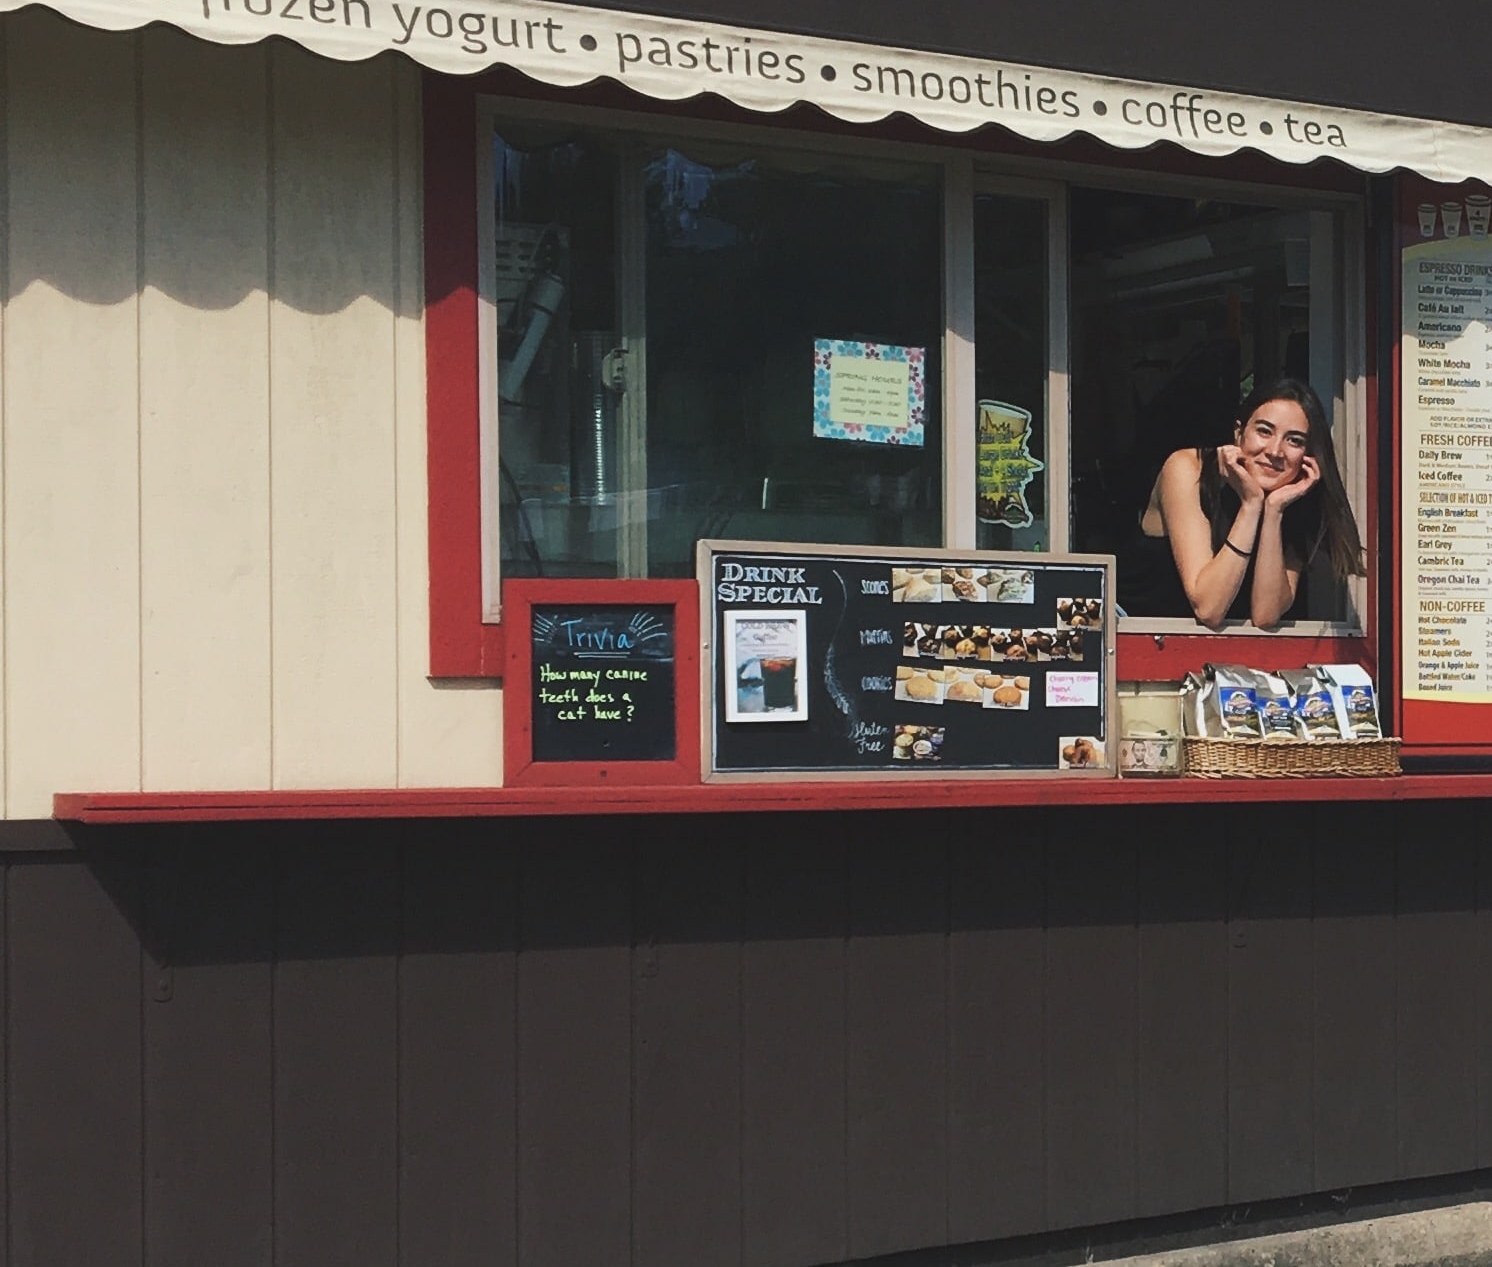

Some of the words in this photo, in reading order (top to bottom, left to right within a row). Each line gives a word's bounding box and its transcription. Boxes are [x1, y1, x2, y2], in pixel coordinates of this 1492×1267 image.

[390, 0, 568, 55] yogurt
[614, 31, 806, 86] pastries
[852, 59, 1082, 120] smoothies
[1120, 91, 1249, 139] coffee
[1283, 110, 1348, 150] tea
[1419, 262, 1463, 274] ESPRESSO
[1438, 304, 1450, 313] Au
[1418, 321, 1462, 332] Americano
[1418, 339, 1446, 350] Mocha
[1418, 358, 1442, 368] White
[1444, 360, 1471, 369] Mocha
[1418, 376, 1446, 386] Caramel
[1446, 378, 1481, 388] Macchiato
[1418, 395, 1456, 406] Espresso
[1420, 434, 1454, 446] FRESH
[1418, 450, 1439, 462] Daily
[1441, 450, 1463, 460] Brew
[1418, 471, 1436, 481] Iced
[1437, 471, 1463, 481] Coffee
[1419, 492, 1448, 503] SELECTION
[1449, 493, 1456, 503] OF
[1457, 493, 1469, 504] HOT
[1475, 494, 1487, 504] ICED
[1418, 507, 1443, 518] English
[1444, 508, 1478, 518] Breakfast
[1418, 523, 1440, 533] Green
[1442, 524, 1457, 533] Zen
[1418, 539, 1433, 549] Earl
[1434, 540, 1452, 551] Grey
[1418, 556, 1449, 566] Cambric
[1451, 556, 1464, 566] Tea
[721, 563, 806, 584] DRINK
[1418, 575, 1446, 586] Oregon
[1447, 574, 1465, 584] Chai
[1466, 575, 1480, 584] Tea
[717, 583, 823, 605] SPECIAL
[1419, 600, 1486, 613] NON-COFFEE
[1418, 616, 1431, 624] Hot
[1432, 617, 1467, 625] Chocolate
[560, 618, 635, 650] Trivia
[1418, 661, 1440, 670] Orange
[540, 663, 566, 683] How
[569, 670, 600, 688] many
[605, 669, 648, 682] canine
[539, 687, 579, 703] teeth
[585, 688, 615, 703] does
[622, 692, 632, 703] a
[557, 705, 587, 720] cat
[855, 737, 885, 754] Free
